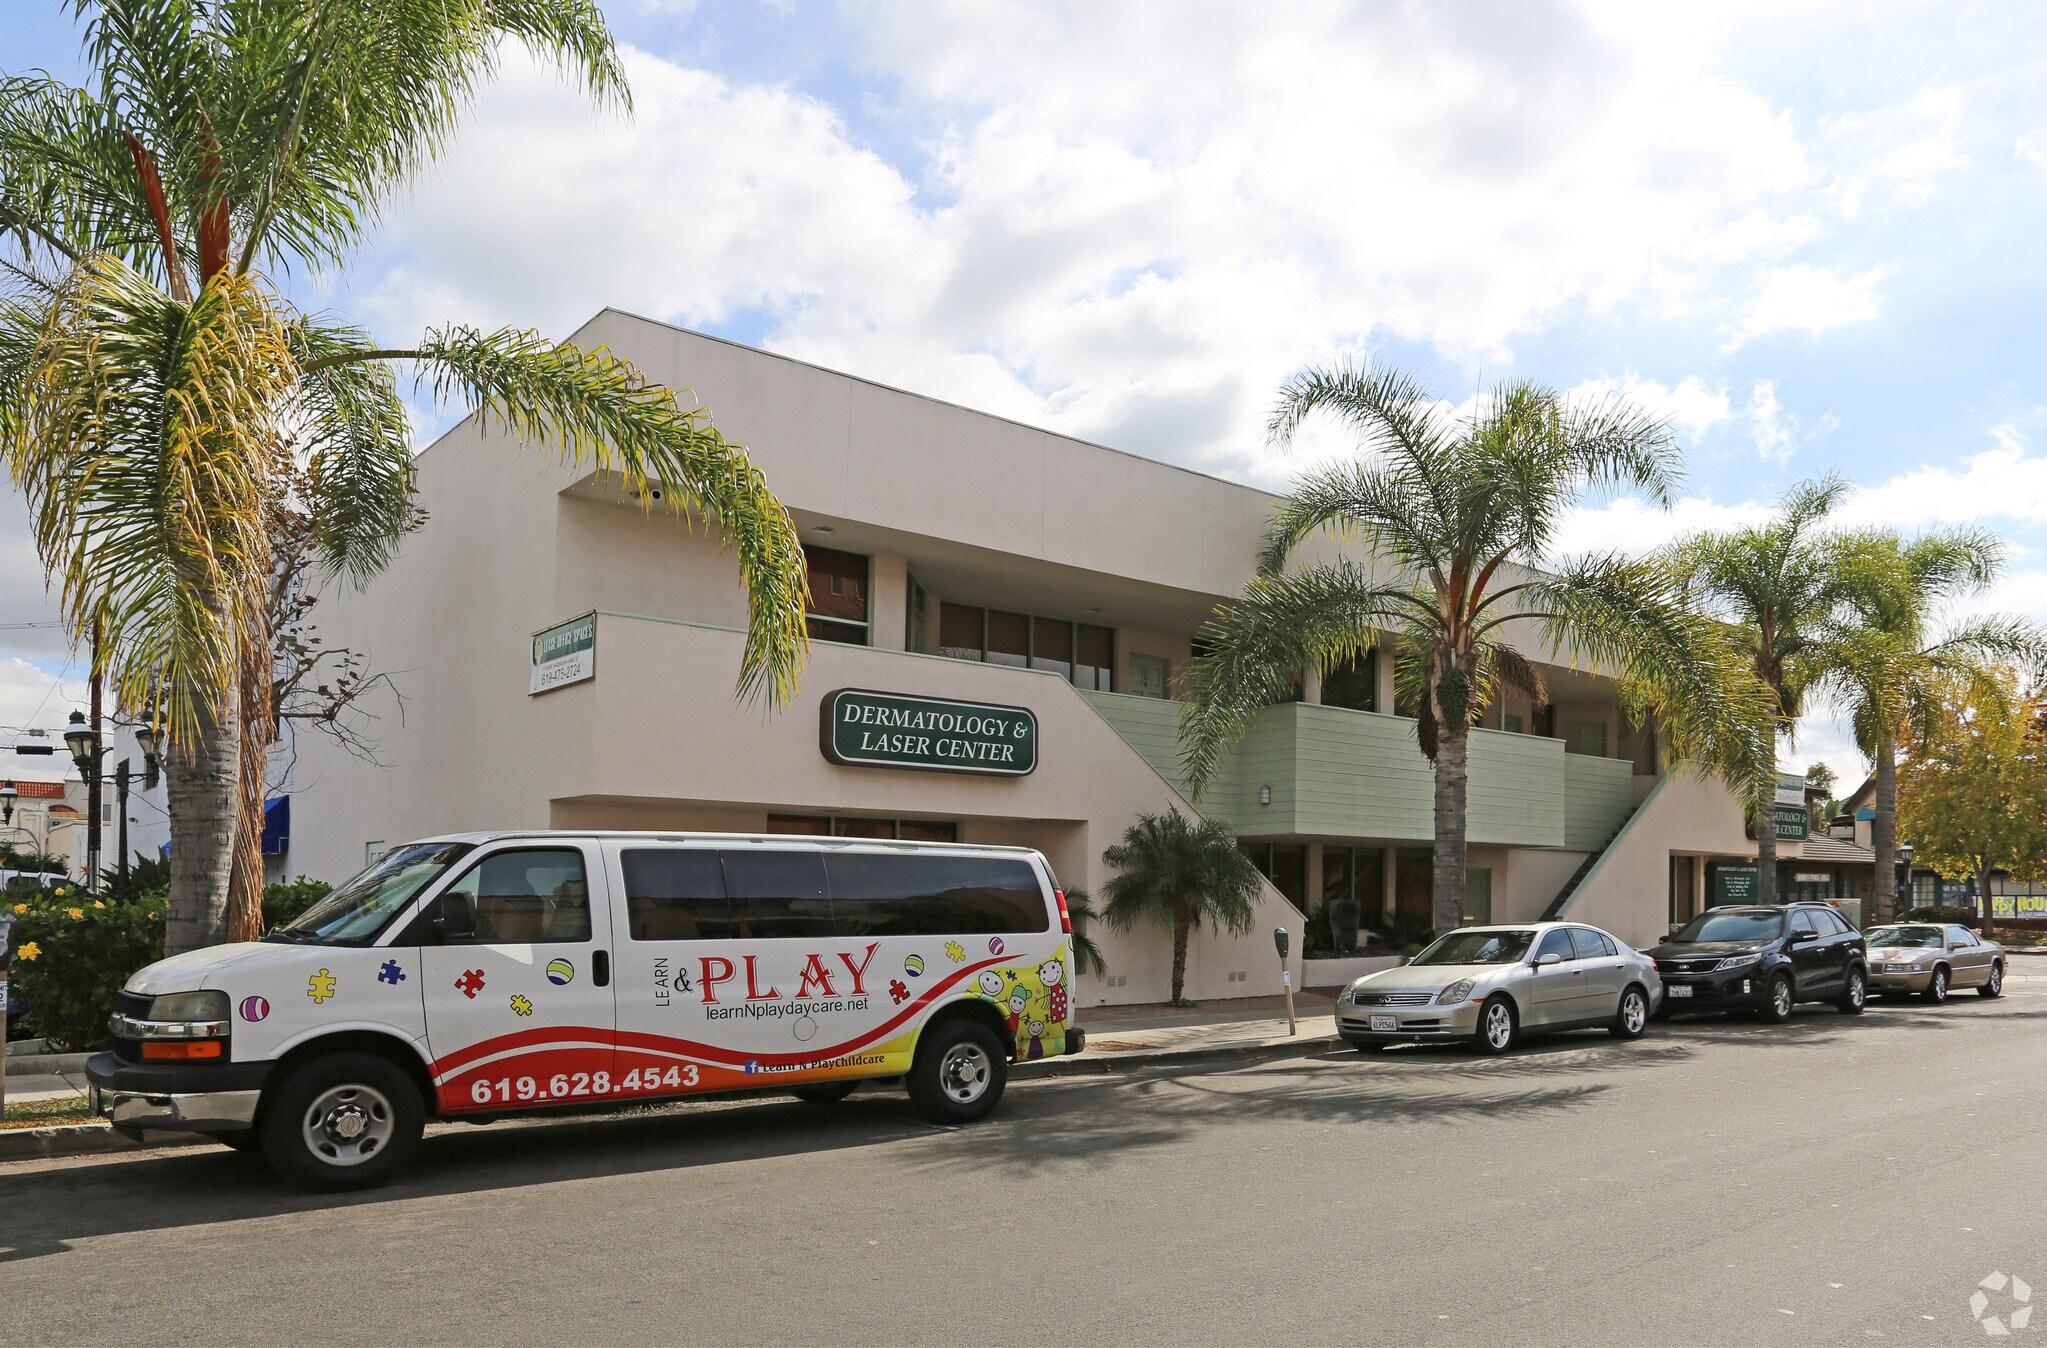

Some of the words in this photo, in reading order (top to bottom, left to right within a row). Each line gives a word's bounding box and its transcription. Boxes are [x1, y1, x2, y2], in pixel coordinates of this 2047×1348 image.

[543, 636, 556, 653] LEASE
[556, 630, 573, 649] OFFICE
[573, 624, 593, 643] SPACES
[541, 663, 581, 686] 619-475-2724
[843, 703, 1008, 737] DERMATOLOGY
[1013, 721, 1028, 739] &
[860, 731, 930, 755] LASER
[936, 738, 1014, 762] CENTER
[1780, 824, 1803, 836] CENTER
[1801, 813, 1807, 823] &
[654, 957, 670, 1007] LEARN
[674, 967, 693, 993] &
[696, 941, 881, 1006] PLAY
[706, 997, 868, 1020] learnNplaydaycare.net
[763, 1062, 795, 1072] Learn
[800, 1061, 807, 1070] N
[471, 1064, 700, 1103] 619.628.4543
